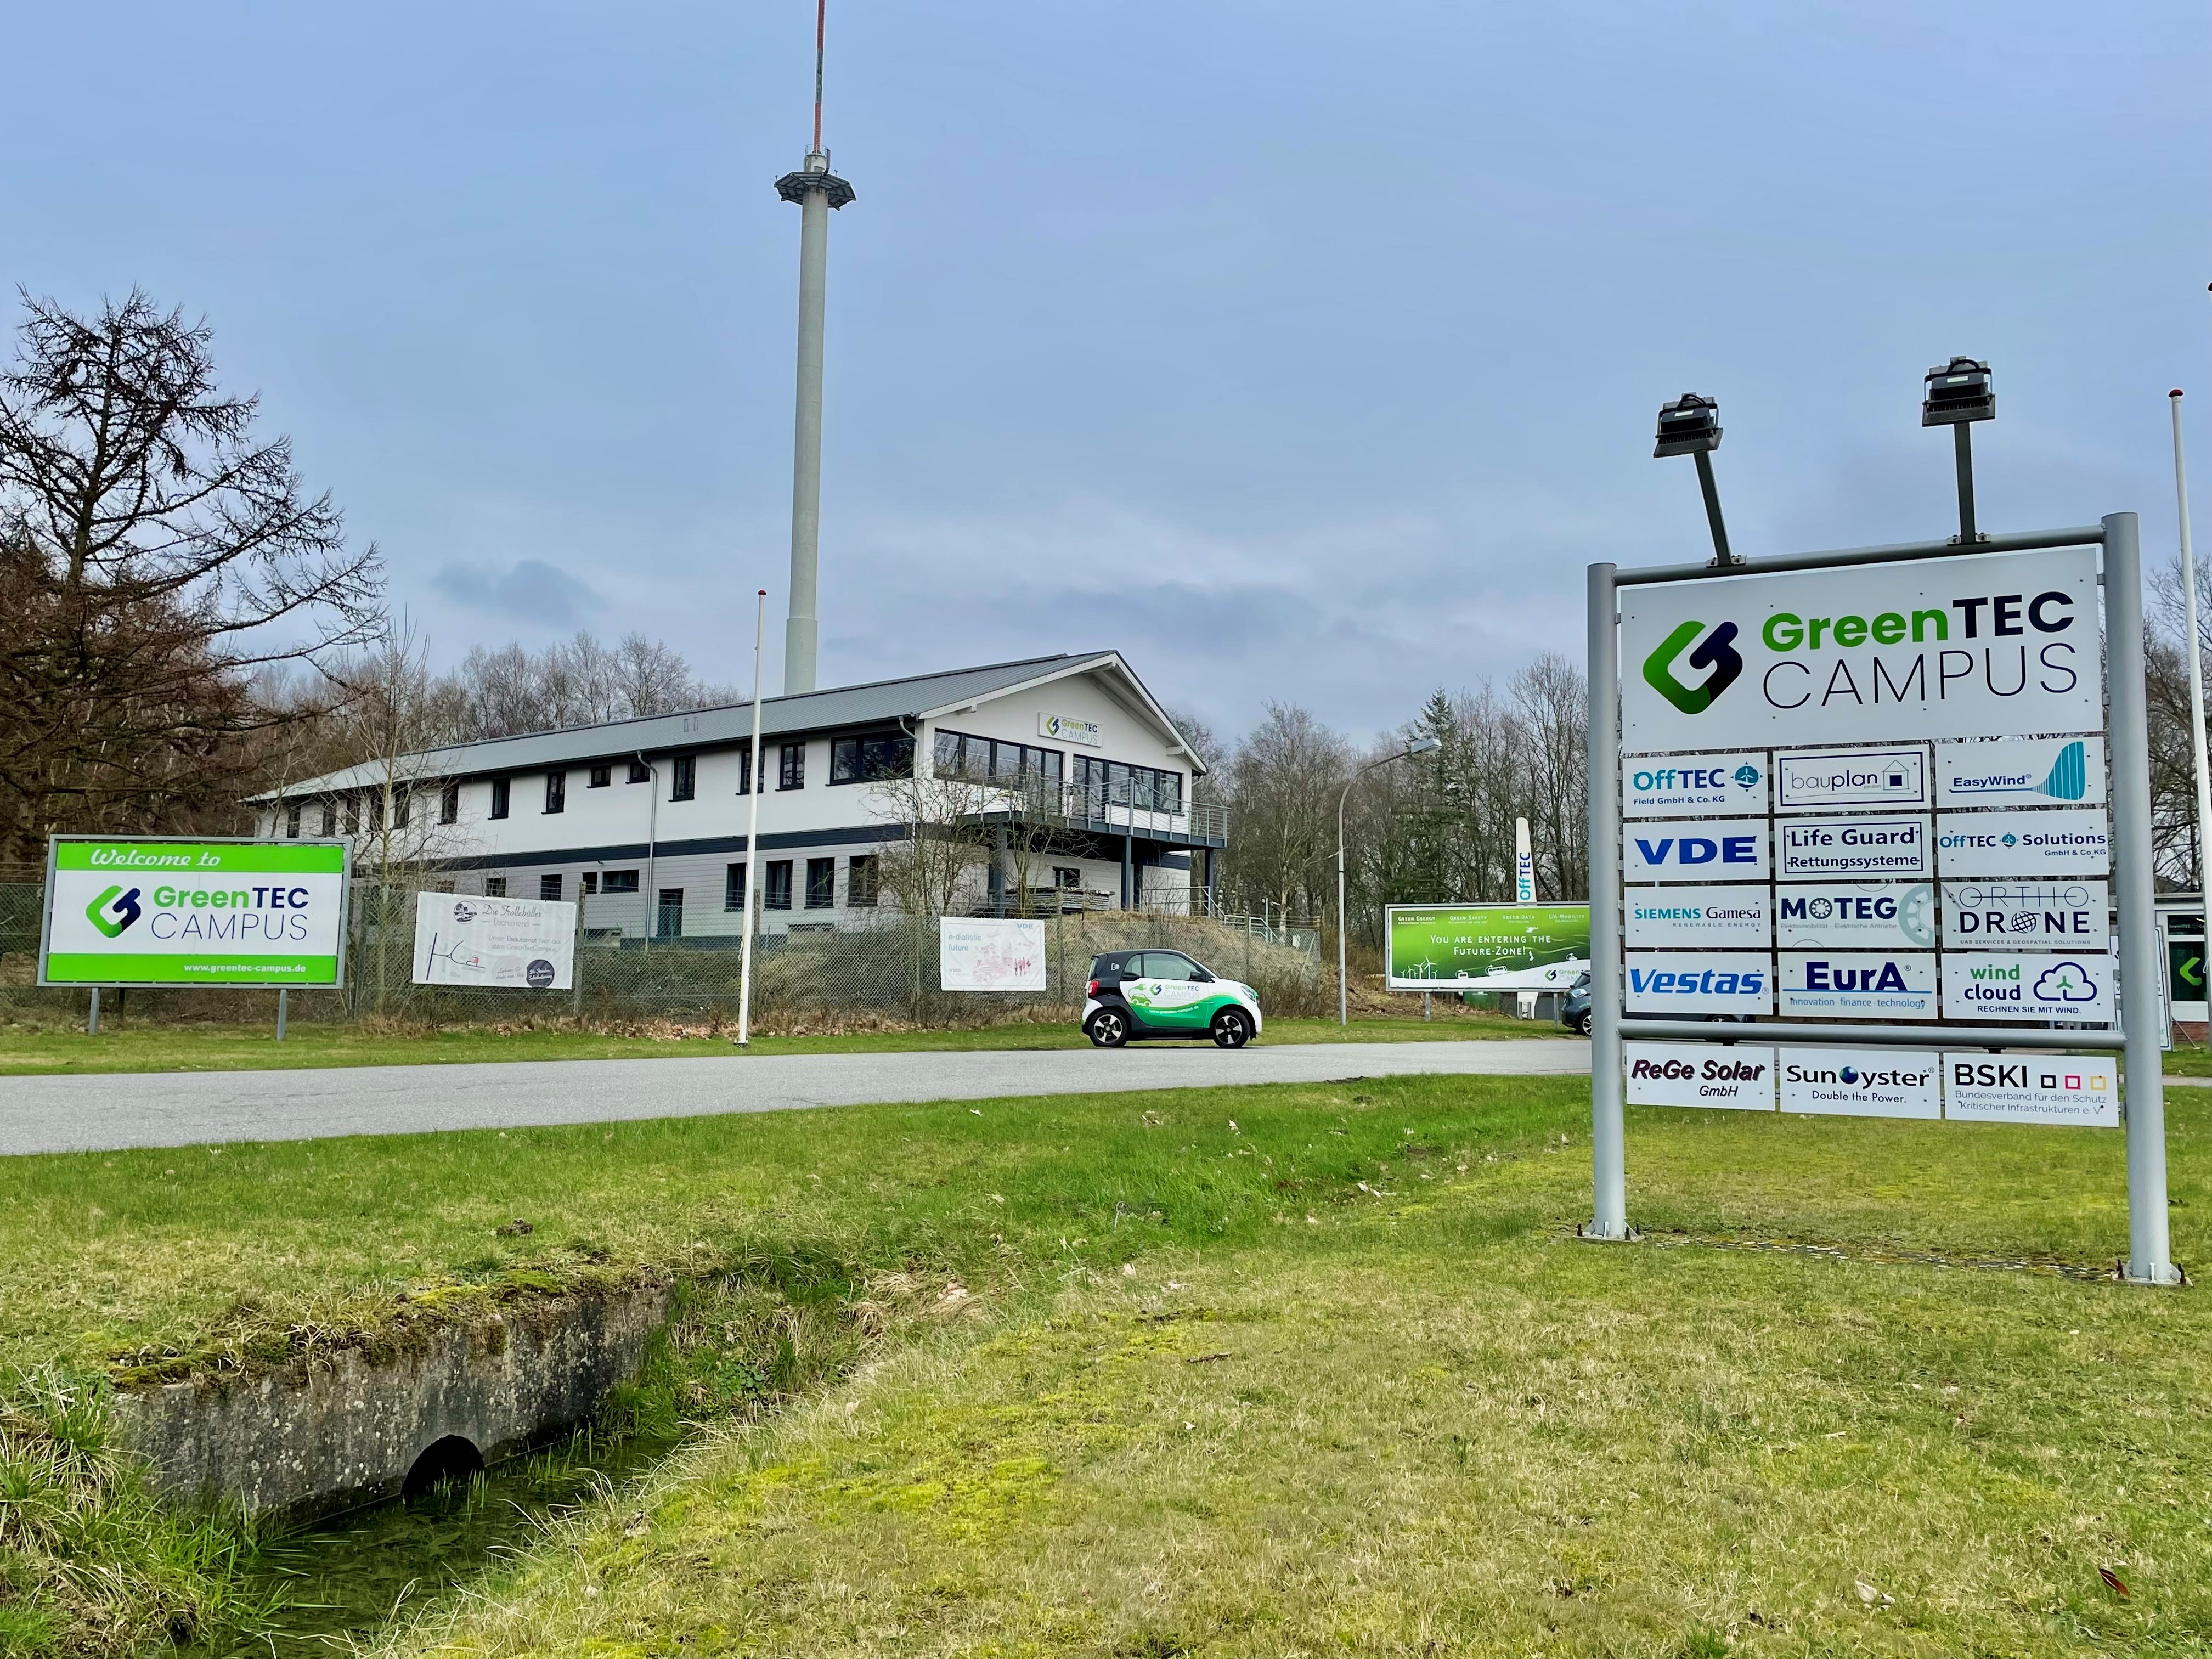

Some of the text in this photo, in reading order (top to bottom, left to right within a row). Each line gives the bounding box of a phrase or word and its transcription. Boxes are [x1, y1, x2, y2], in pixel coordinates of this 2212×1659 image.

[1762, 591, 2075, 652] GreenTEC
[1763, 642, 2078, 709] CAMPUS
[1062, 719, 1097, 732] GreenTEC
[1062, 729, 1097, 744] CAMPUS
[1633, 769, 1725, 790] OffTEC
[1792, 770, 1878, 791] bauplan
[1791, 827, 1915, 847] Life Guard
[1939, 833, 2106, 848] OffTEC Solutions
[91, 848, 221, 867] Welcome to
[1634, 837, 1757, 865] VDE
[1790, 856, 1918, 869] Rettungssysteme
[1519, 852, 1531, 900] OffTEC
[154, 886, 308, 909] GreenTEC
[1959, 887, 2089, 907] ORTHO
[482, 904, 498, 915] Die
[1635, 907, 1760, 919] SIEMENS Gamesa
[1781, 897, 1897, 919] MOTEG
[151, 912, 307, 940] CAMPUS
[1960, 911, 2090, 933] DRONE
[184, 963, 306, 973] www.greentec-campus.de
[1970, 964, 2020, 980] wind
[1164, 990, 1200, 998] CAMPUS
[1964, 984, 2021, 1000] cloud
[1841, 997, 1871, 1006] finance
[1877, 998, 1925, 1009] technology
[1631, 1059, 1765, 1081] ReGe Solar
[1955, 1064, 2028, 1088] BSKI
[1700, 1085, 1738, 1097] GmbH
[1812, 1091, 1906, 1103] Double the Power.
[1955, 1091, 2031, 1101] Bundesverband
[2051, 1093, 2069, 1102] den
[2073, 1094, 2107, 1103] Schutz
[1961, 1102, 2005, 1111] Kritischer
[2008, 1103, 2080, 1114] Infrastrukturen
